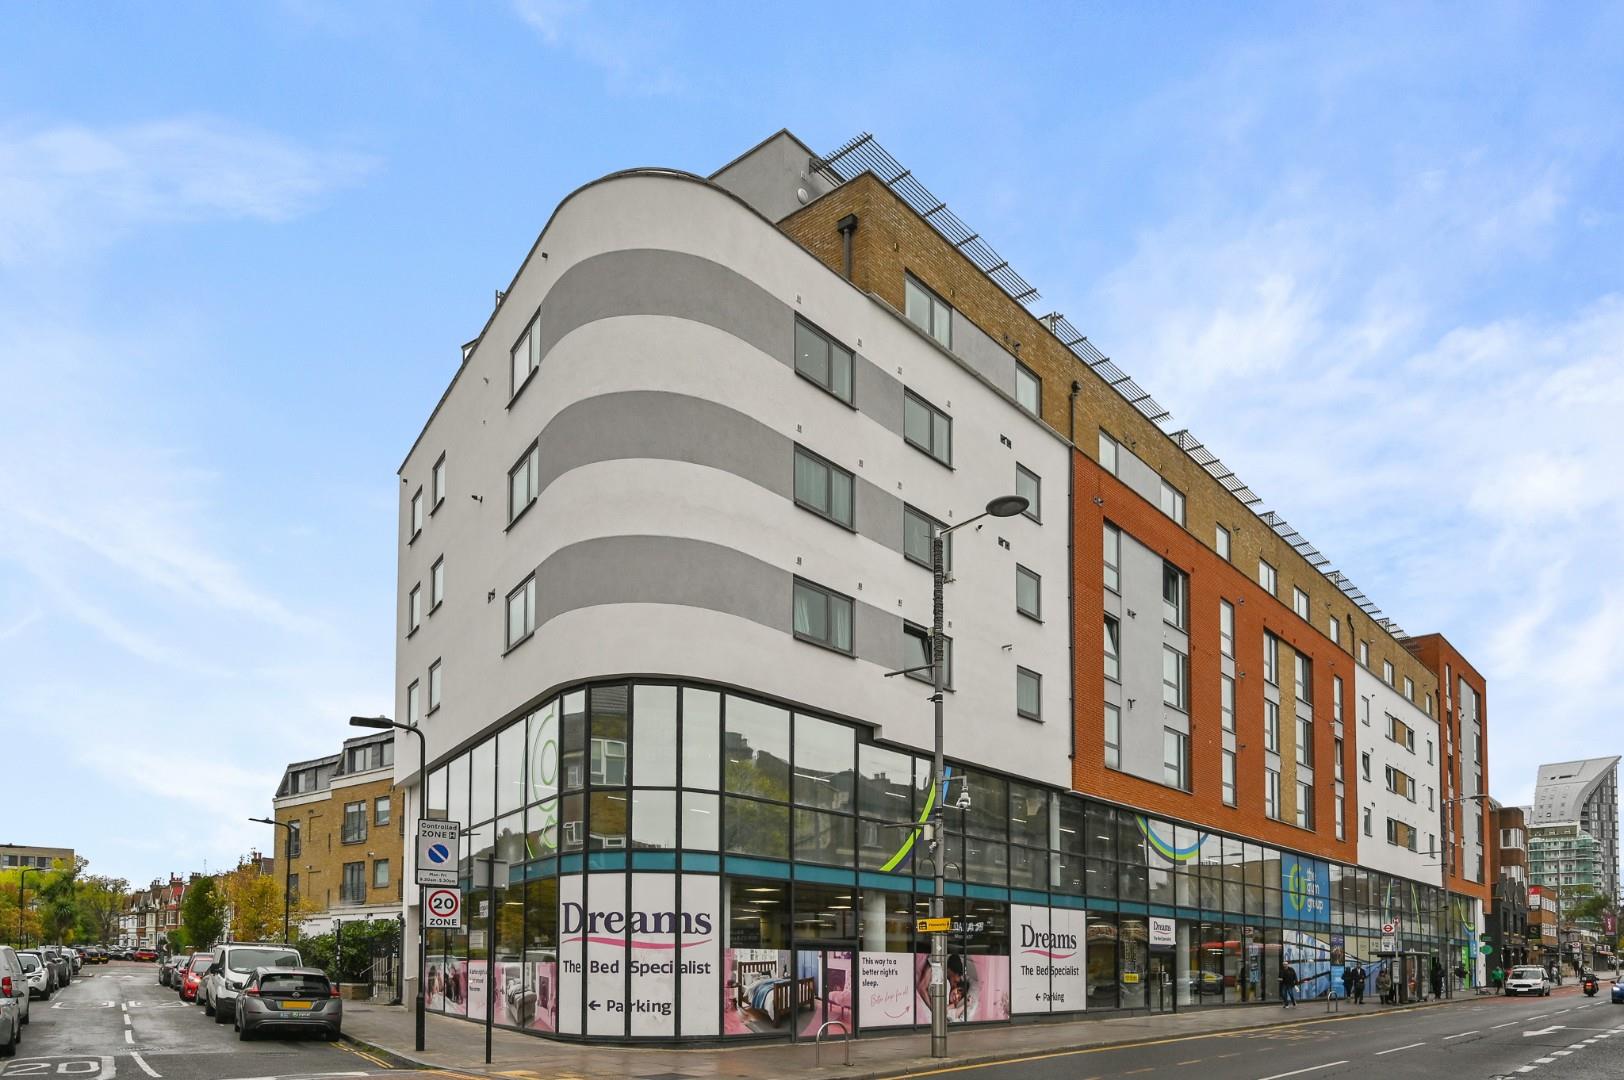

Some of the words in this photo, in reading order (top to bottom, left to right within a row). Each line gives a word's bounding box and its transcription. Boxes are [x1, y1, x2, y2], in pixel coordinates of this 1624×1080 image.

[421, 822, 457, 830] Controlled
[421, 830, 447, 838] ZONE
[433, 898, 454, 909] 20
[1306, 898, 1324, 913] grup
[430, 918, 457, 926] ZONE
[561, 902, 712, 935] Dreams
[1020, 924, 1077, 949] Dreams
[862, 957, 873, 965] This
[563, 960, 581, 973] The
[590, 960, 619, 973] Bed
[630, 960, 711, 977] Specialist
[862, 968, 879, 976] better
[880, 968, 898, 977] night's
[1020, 965, 1034, 976] The
[1036, 965, 1048, 976] Bed
[1050, 966, 1079, 978] Specialist
[862, 979, 879, 988] sleep.
[1043, 992, 1065, 1003] Parking
[606, 1000, 672, 1015] Parking
[1, 1061, 99, 1077] 20
